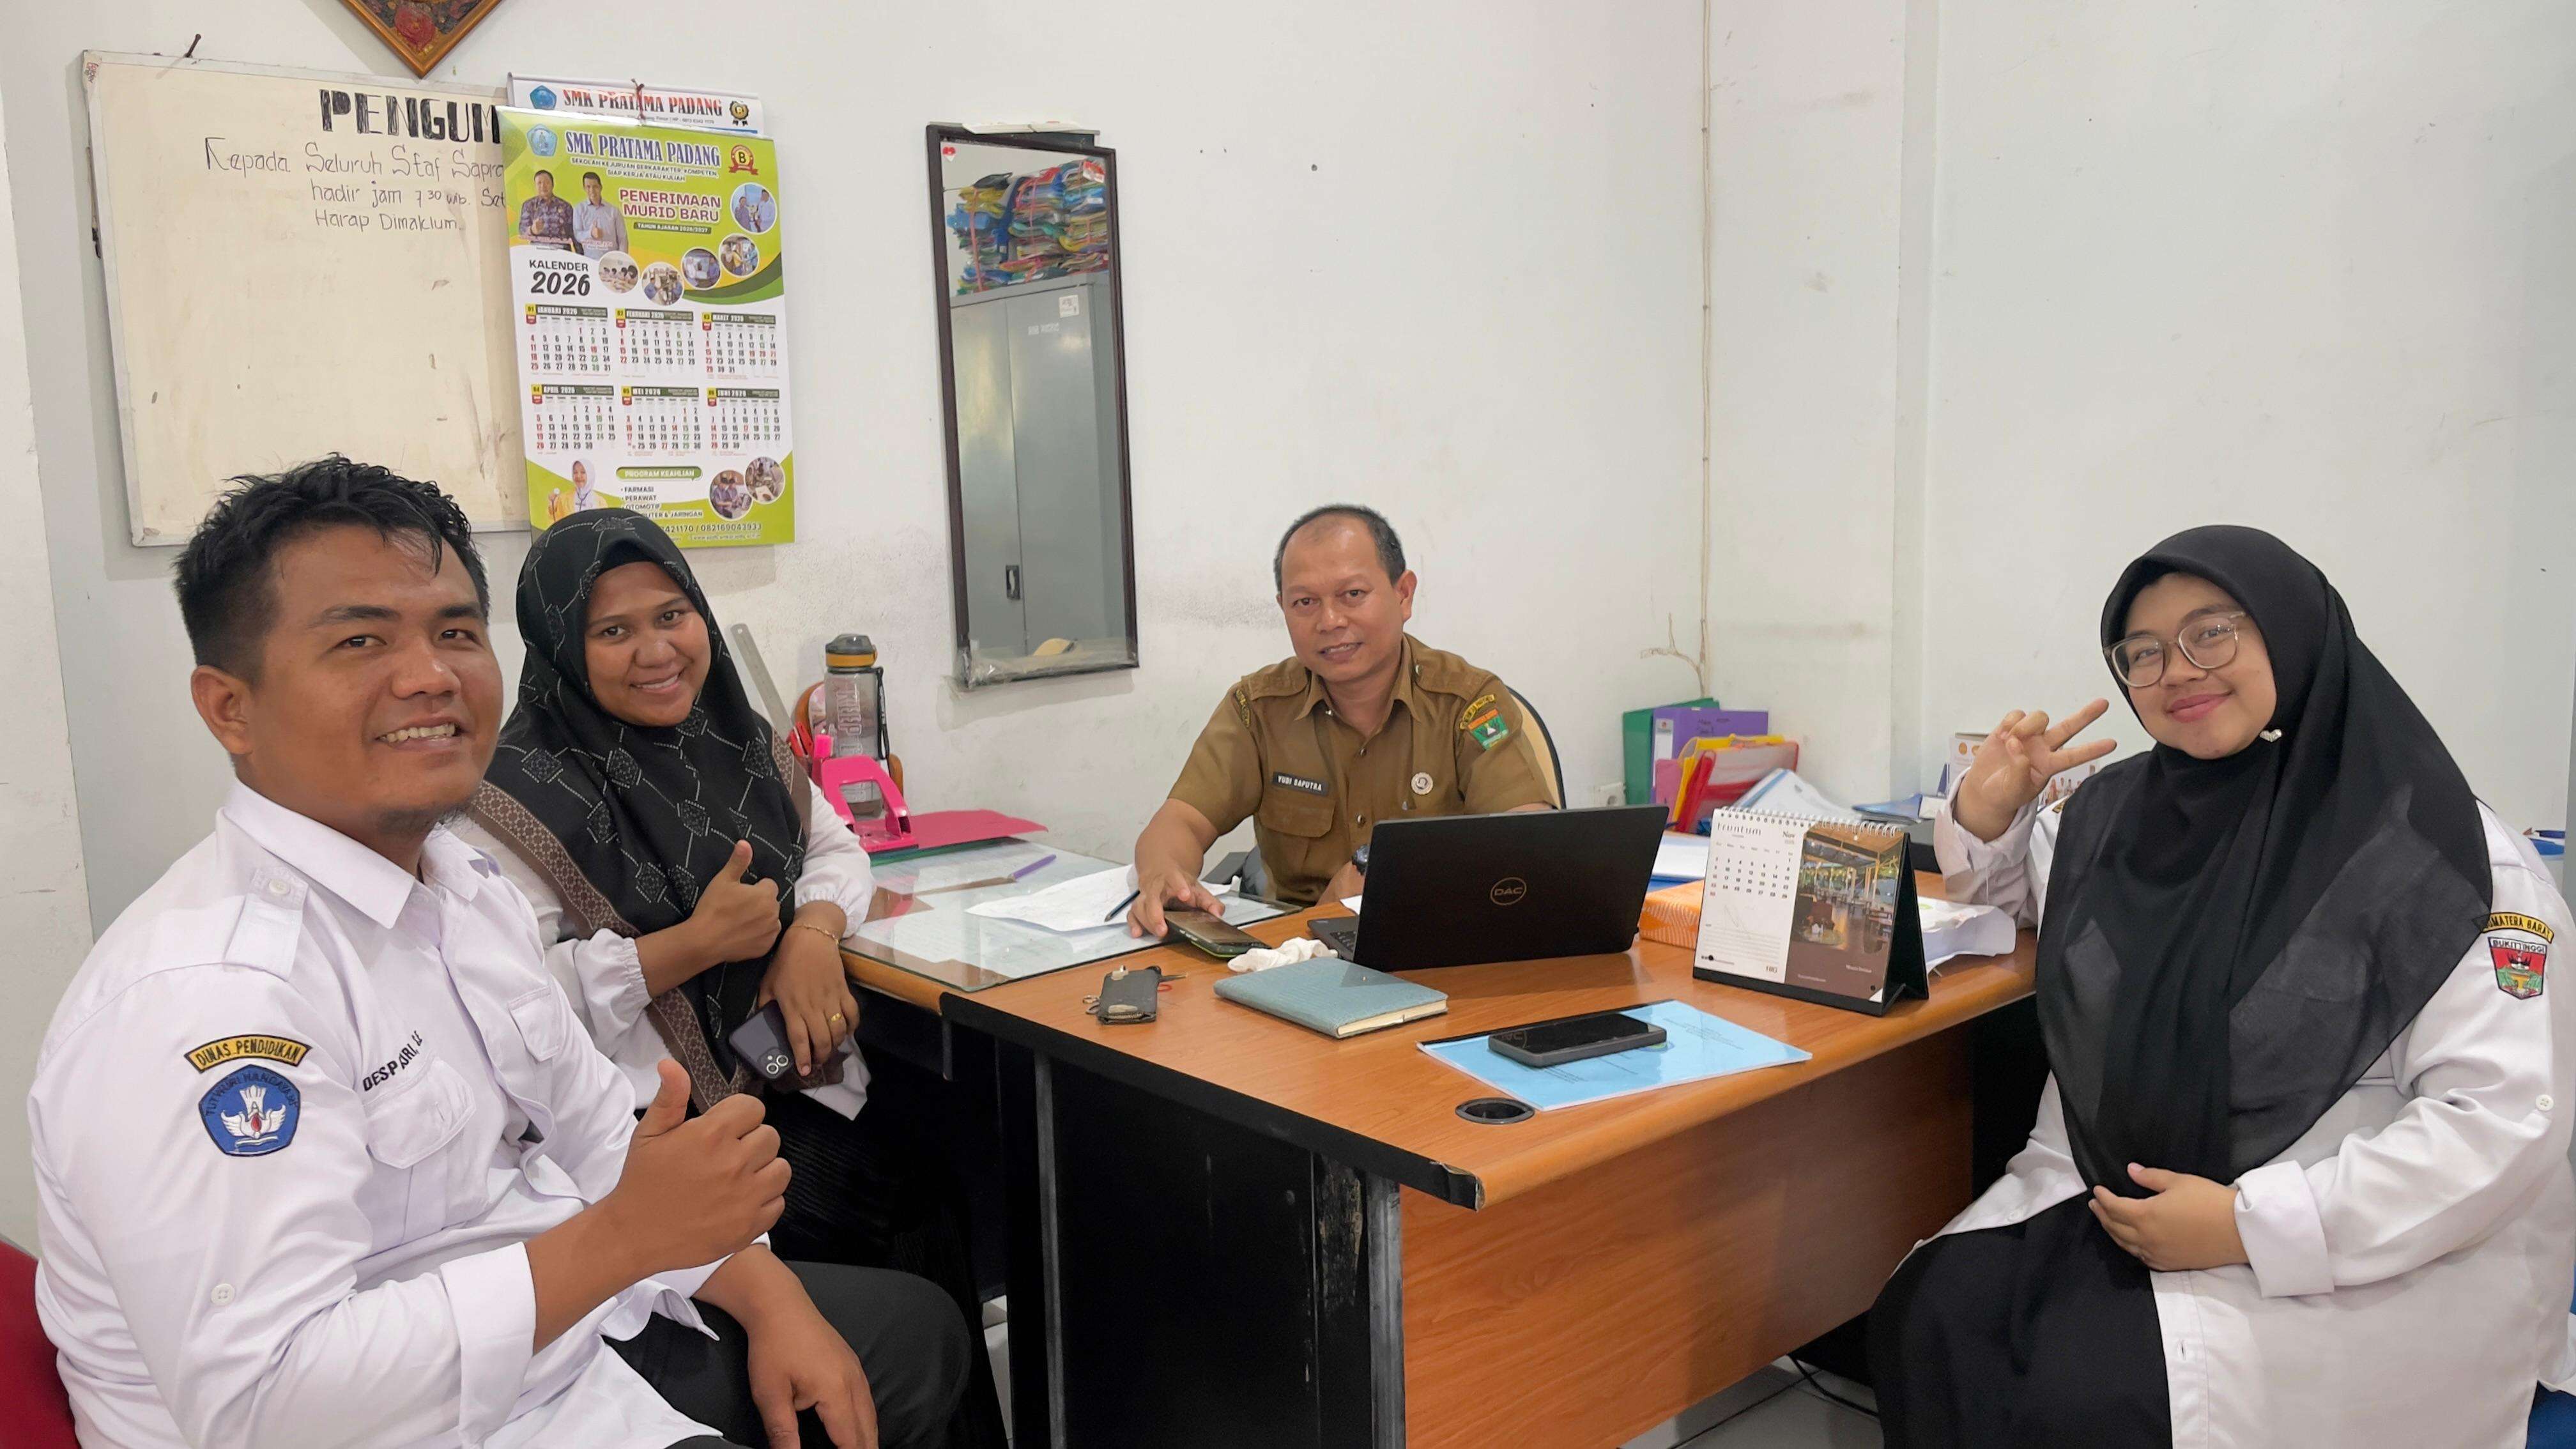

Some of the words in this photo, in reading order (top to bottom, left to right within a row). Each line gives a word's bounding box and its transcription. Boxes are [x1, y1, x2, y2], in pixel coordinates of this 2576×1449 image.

[564, 89, 594, 107] SMK
[599, 93, 664, 112] PRATAMA
[668, 96, 722, 116] PADANG
[205, 137, 291, 178] Kepada
[305, 142, 382, 175] Seluruh
[392, 144, 440, 181] Staf
[565, 132, 594, 155] SMK
[599, 135, 663, 161] PRATAMA
[667, 142, 721, 167] PADANG
[739, 151, 746, 164] B
[310, 178, 360, 203] hadir
[372, 180, 401, 208] jam
[620, 189, 721, 208] PENERIMAAN
[315, 209, 369, 233] Harap
[624, 204, 675, 218] MURID
[680, 208, 719, 222] BARU
[529, 259, 588, 272] KALENDER
[531, 271, 590, 296] 2026
[662, 525, 694, 533] 421170
[1278, 775, 1292, 785] YUDI
[1294, 778, 1322, 792] SAPUTRA
[2487, 915, 2524, 928] MATERA
[2527, 919, 2550, 937] BARAT
[195, 1043, 232, 1066] DINAS
[235, 1038, 302, 1061] PENDIDIKAN
